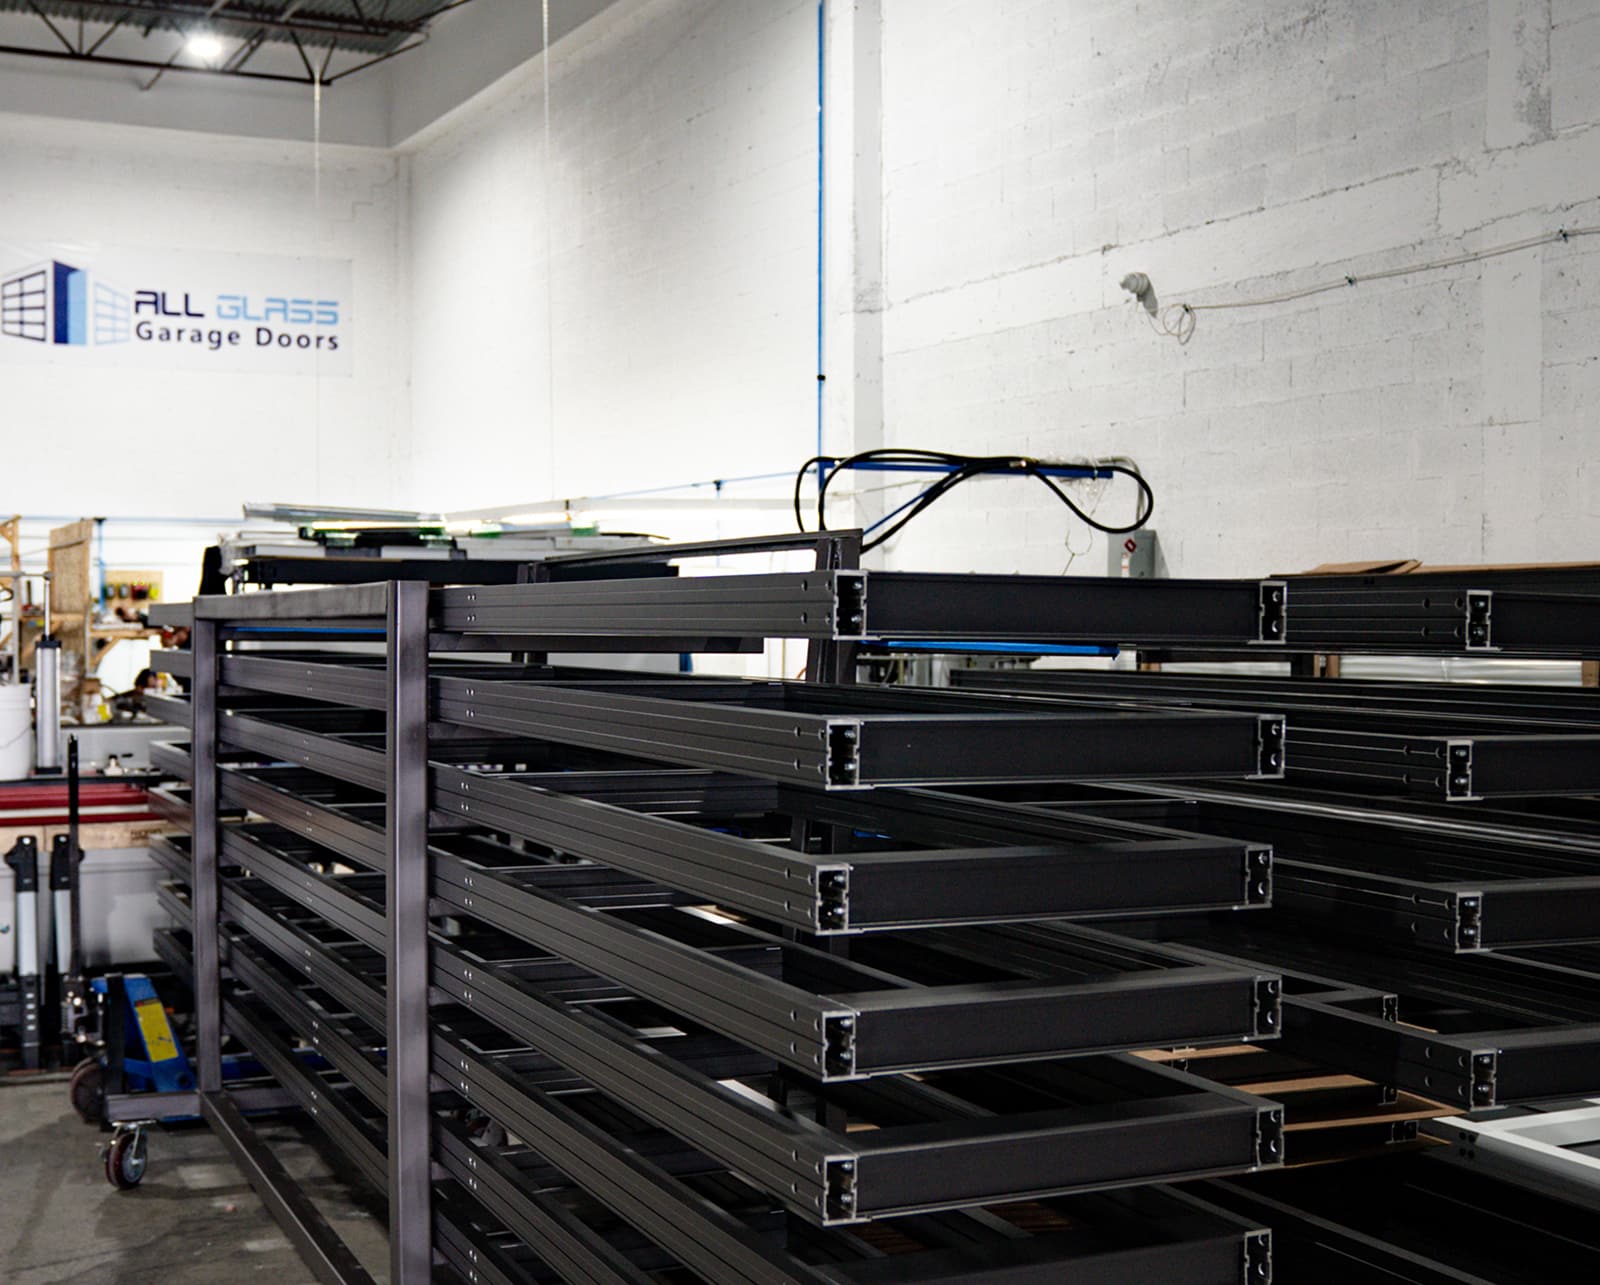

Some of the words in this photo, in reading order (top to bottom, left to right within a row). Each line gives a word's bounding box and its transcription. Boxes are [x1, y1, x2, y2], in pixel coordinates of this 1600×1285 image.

[135, 291, 204, 317] ALL
[216, 295, 339, 325] GLASS
[135, 321, 241, 350] Garage
[256, 327, 339, 350] Doors
